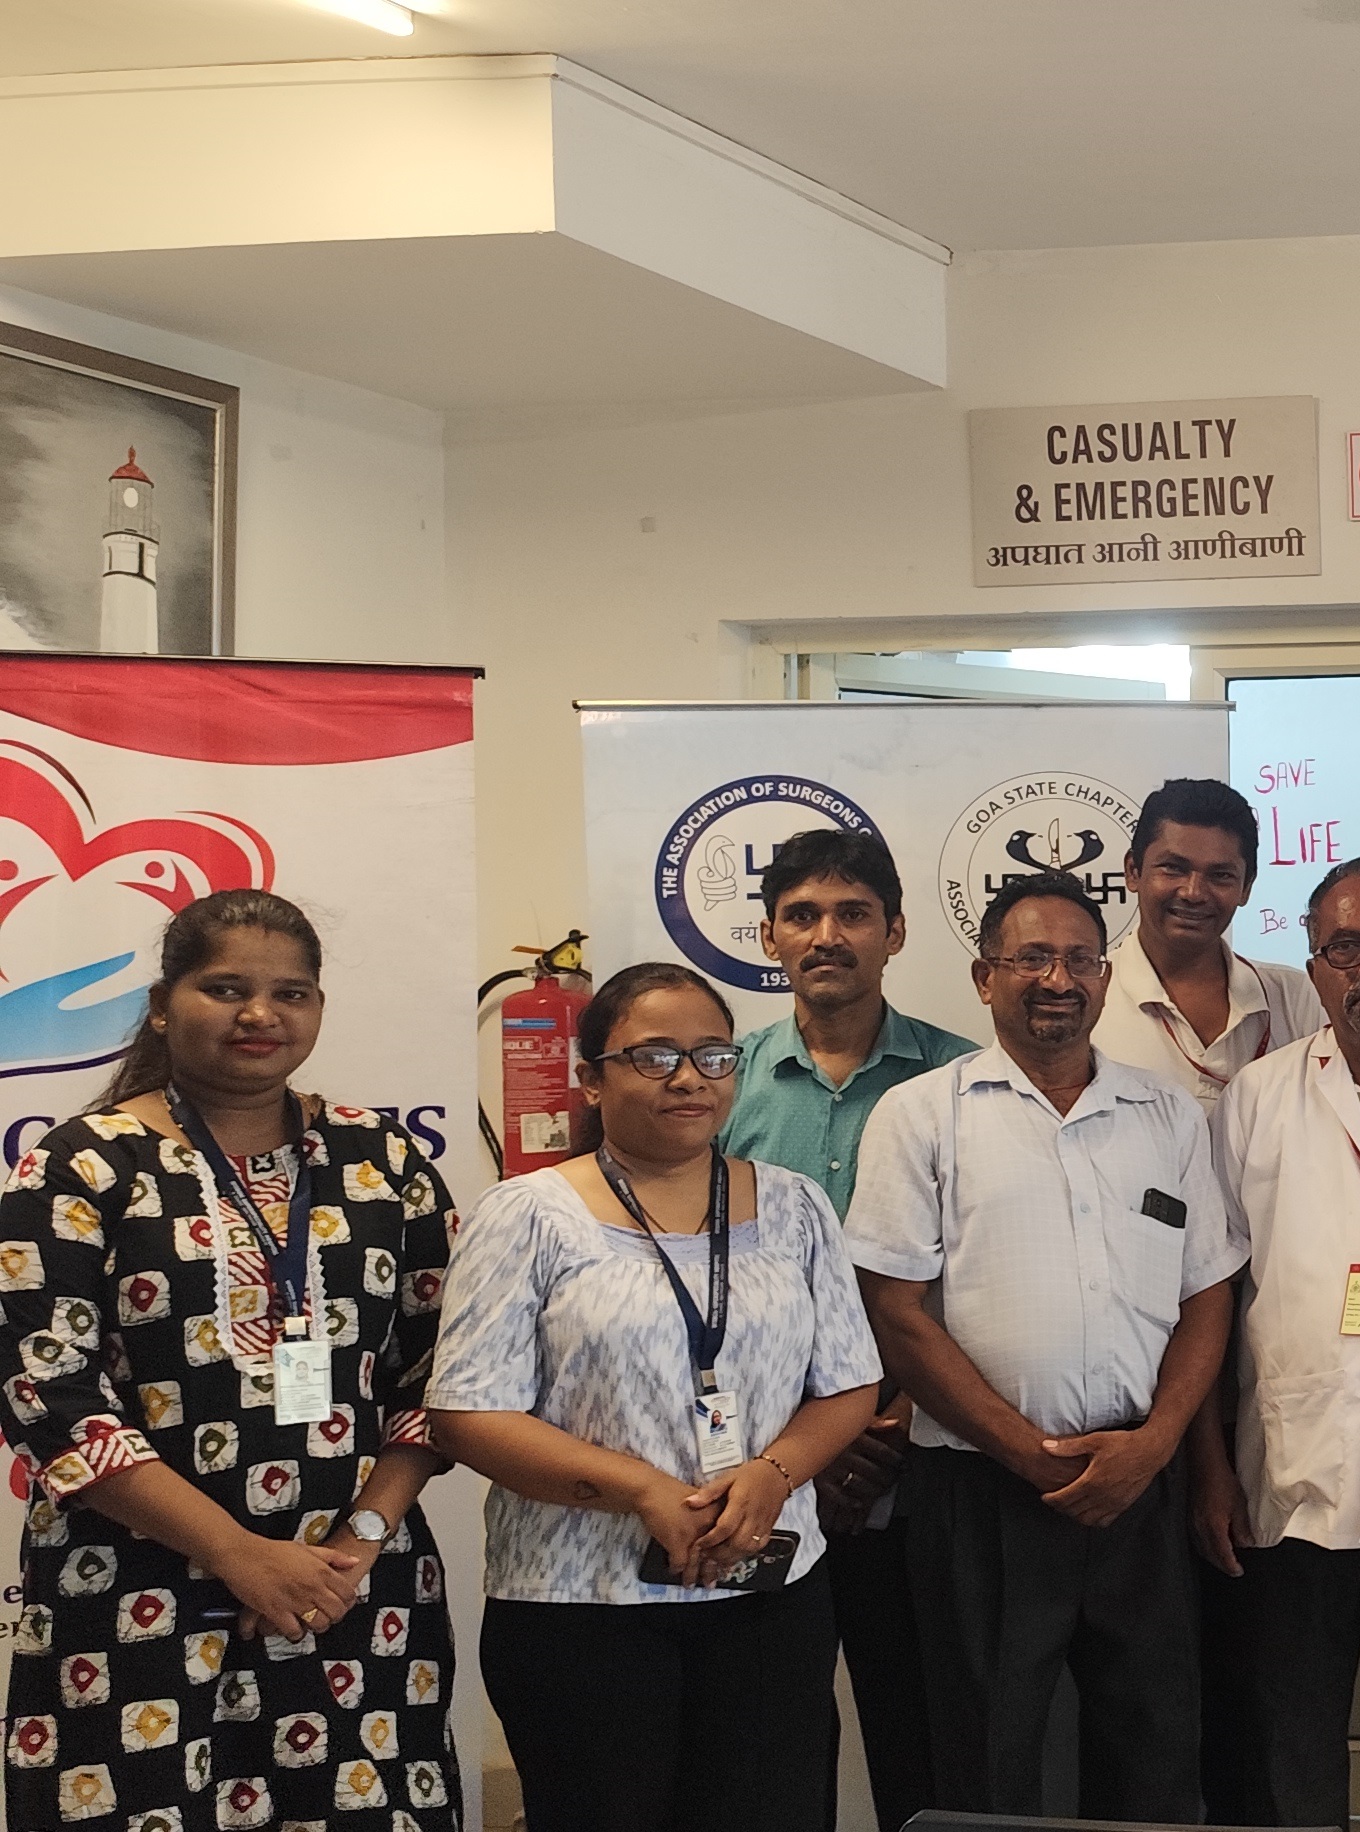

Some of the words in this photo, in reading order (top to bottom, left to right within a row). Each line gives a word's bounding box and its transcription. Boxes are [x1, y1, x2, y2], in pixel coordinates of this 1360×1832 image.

[1046, 418, 1237, 466] CASUALTY
[1014, 483, 1042, 524] &
[1054, 474, 1275, 523] EMERGENCY
[986, 543, 1087, 568] अपघात
[1092, 532, 1162, 564] आनी
[1167, 527, 1307, 561] आणीबाणी
[750, 781, 774, 797] OF
[1253, 758, 1316, 795] SAVE
[664, 786, 748, 866] ASSOCIATION
[777, 782, 863, 830] SURGEONS
[966, 800, 1003, 834] GOA
[1003, 781, 1058, 805] STATE
[1064, 782, 1140, 834] CHAPTER
[1269, 805, 1344, 866] LIFE
[661, 866, 678, 899] THE
[730, 921, 759, 944] वयं
[946, 879, 982, 950] ASSOCIA
[1259, 908, 1289, 935] Be
[760, 971, 791, 987] 193
